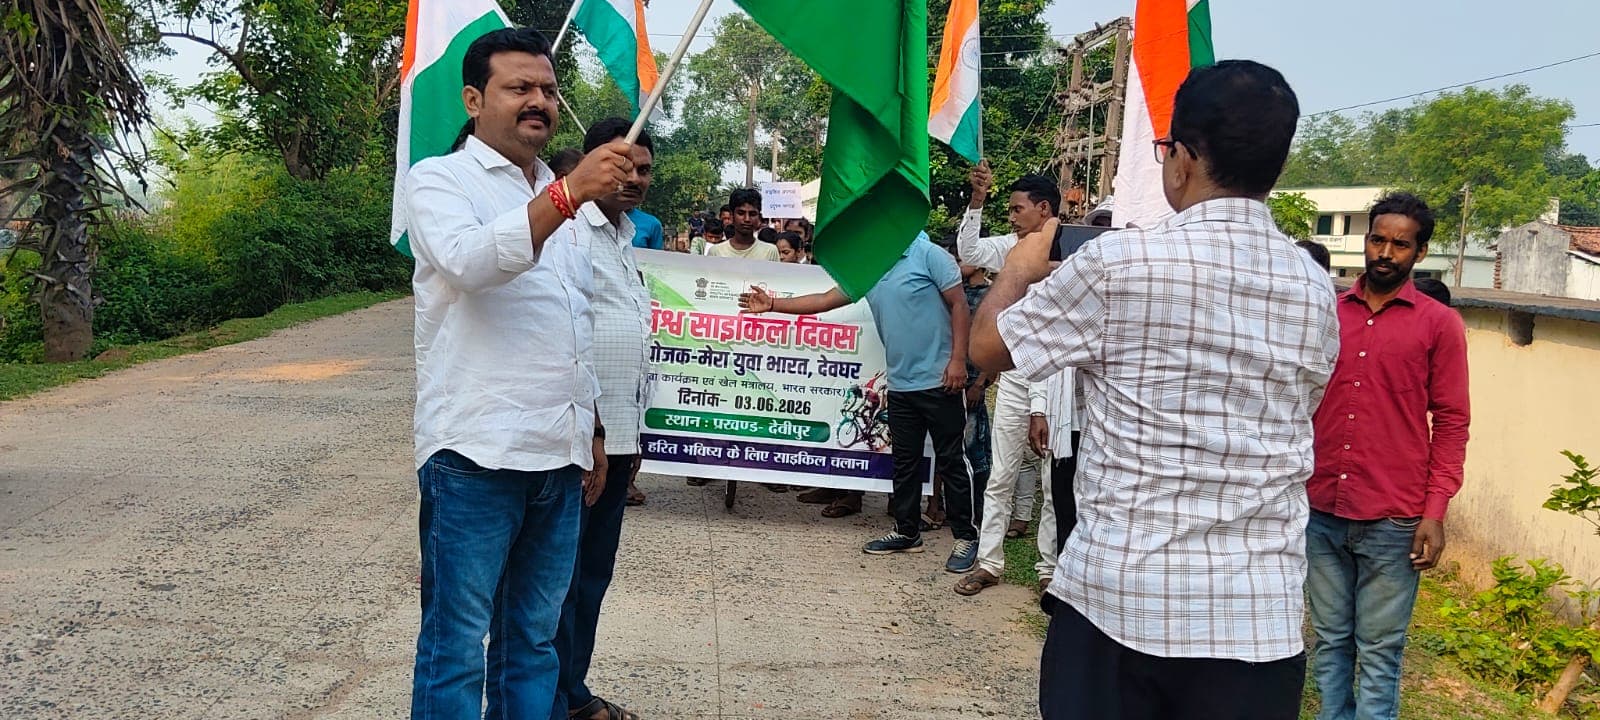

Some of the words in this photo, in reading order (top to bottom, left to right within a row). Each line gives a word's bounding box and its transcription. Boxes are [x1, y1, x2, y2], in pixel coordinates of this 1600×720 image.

[689, 311, 791, 344] साइकिल
[795, 315, 859, 349] दिवस
[733, 352, 763, 375] युवा
[766, 355, 812, 378] भारत,
[817, 355, 862, 379] देवघर
[662, 372, 698, 384] कार्यक्रम
[703, 376, 716, 385] एवं
[719, 376, 737, 387] खेल
[782, 383, 806, 394] भारत
[810, 386, 846, 397] सरकार)
[734, 395, 811, 415] 03.06.2026
[665, 414, 700, 428] स्थान
[768, 420, 811, 440] देवीपुर
[647, 439, 678, 454] हरित
[683, 443, 723, 458] भविष्य
[727, 445, 740, 459] के
[744, 446, 769, 462] लिए
[773, 451, 826, 467] साइकिल
[831, 456, 869, 471] चलाना
